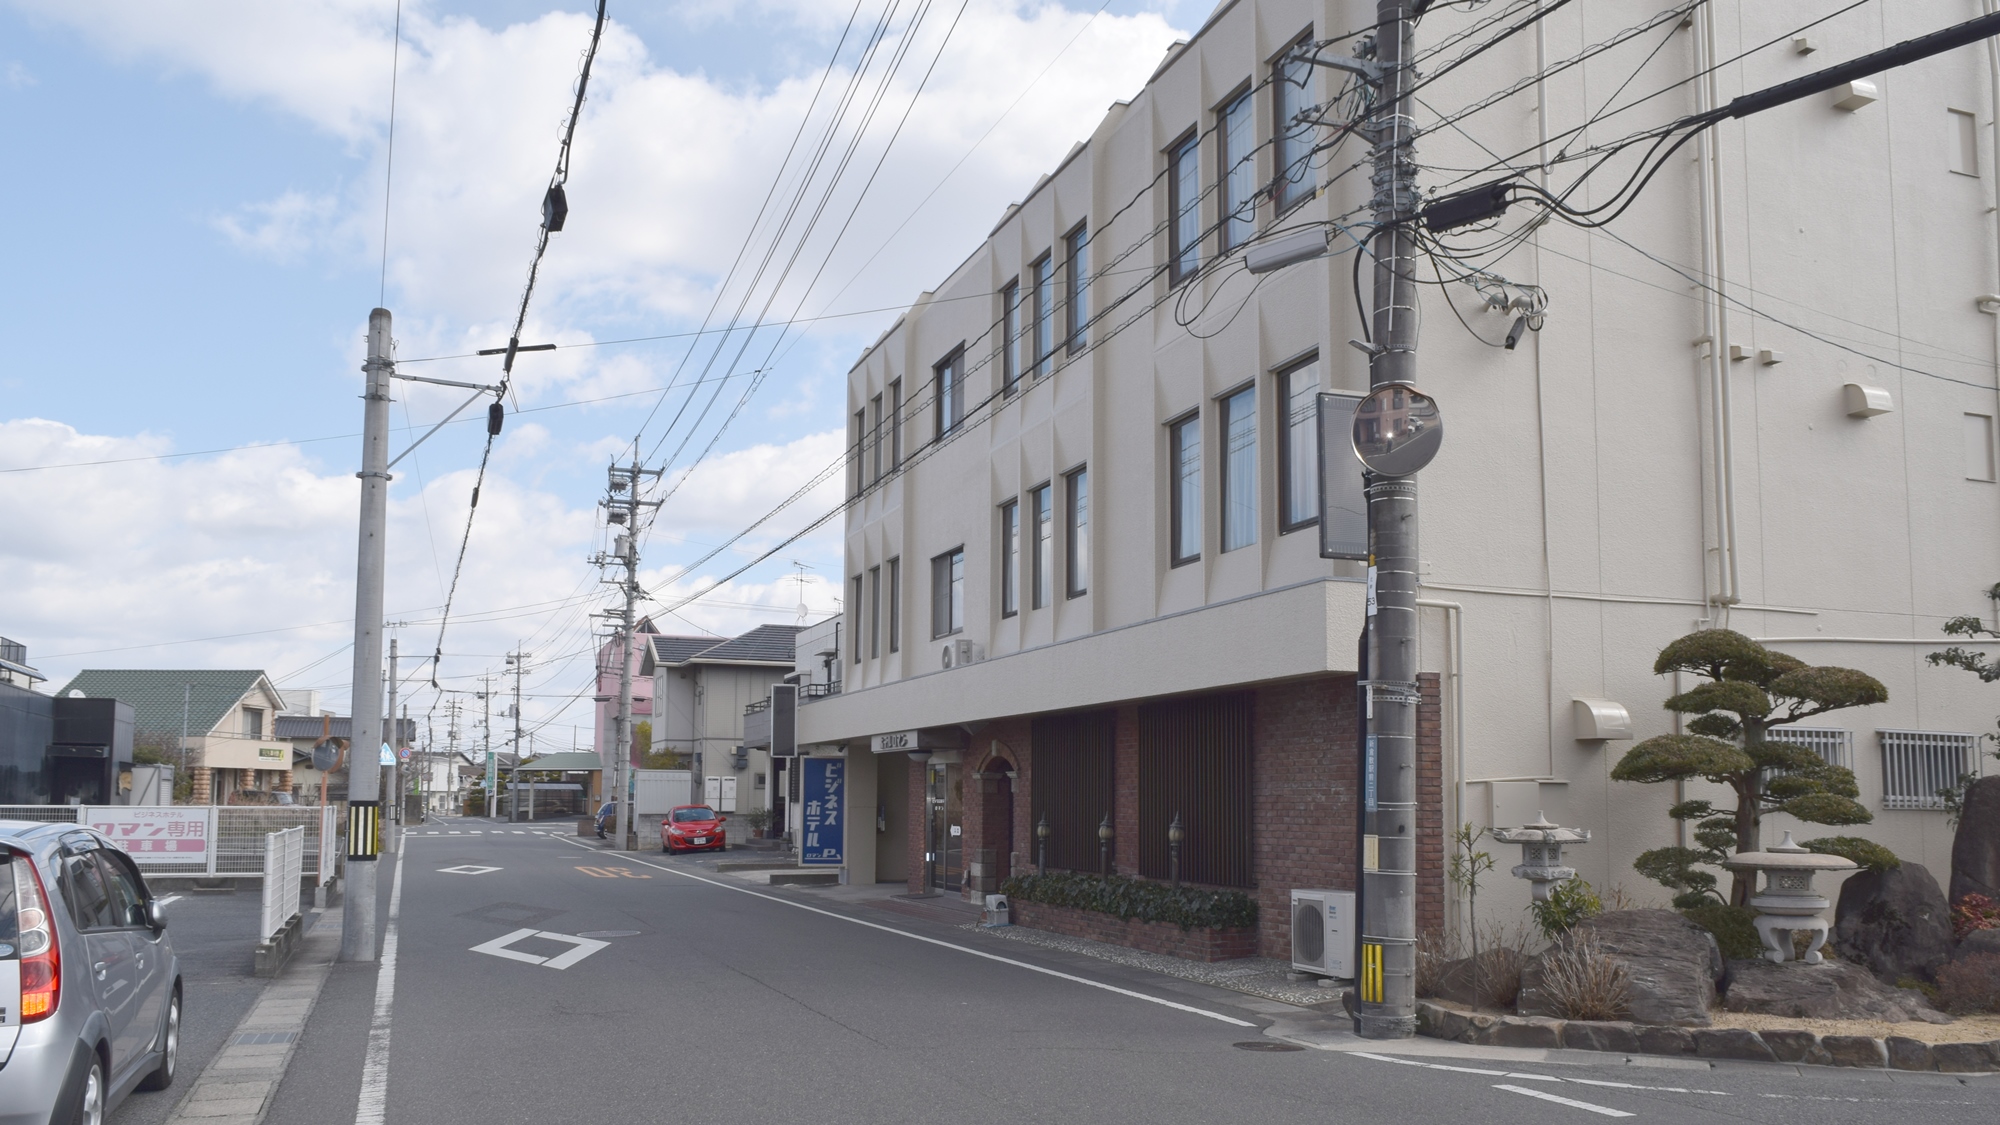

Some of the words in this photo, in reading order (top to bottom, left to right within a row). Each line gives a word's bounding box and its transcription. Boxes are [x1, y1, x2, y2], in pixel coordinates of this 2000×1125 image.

[824, 763, 842, 826] ビジネス
[133, 811, 184, 819] ビジネスホテル
[806, 800, 822, 848] ホテル
[822, 848, 837, 858] P
